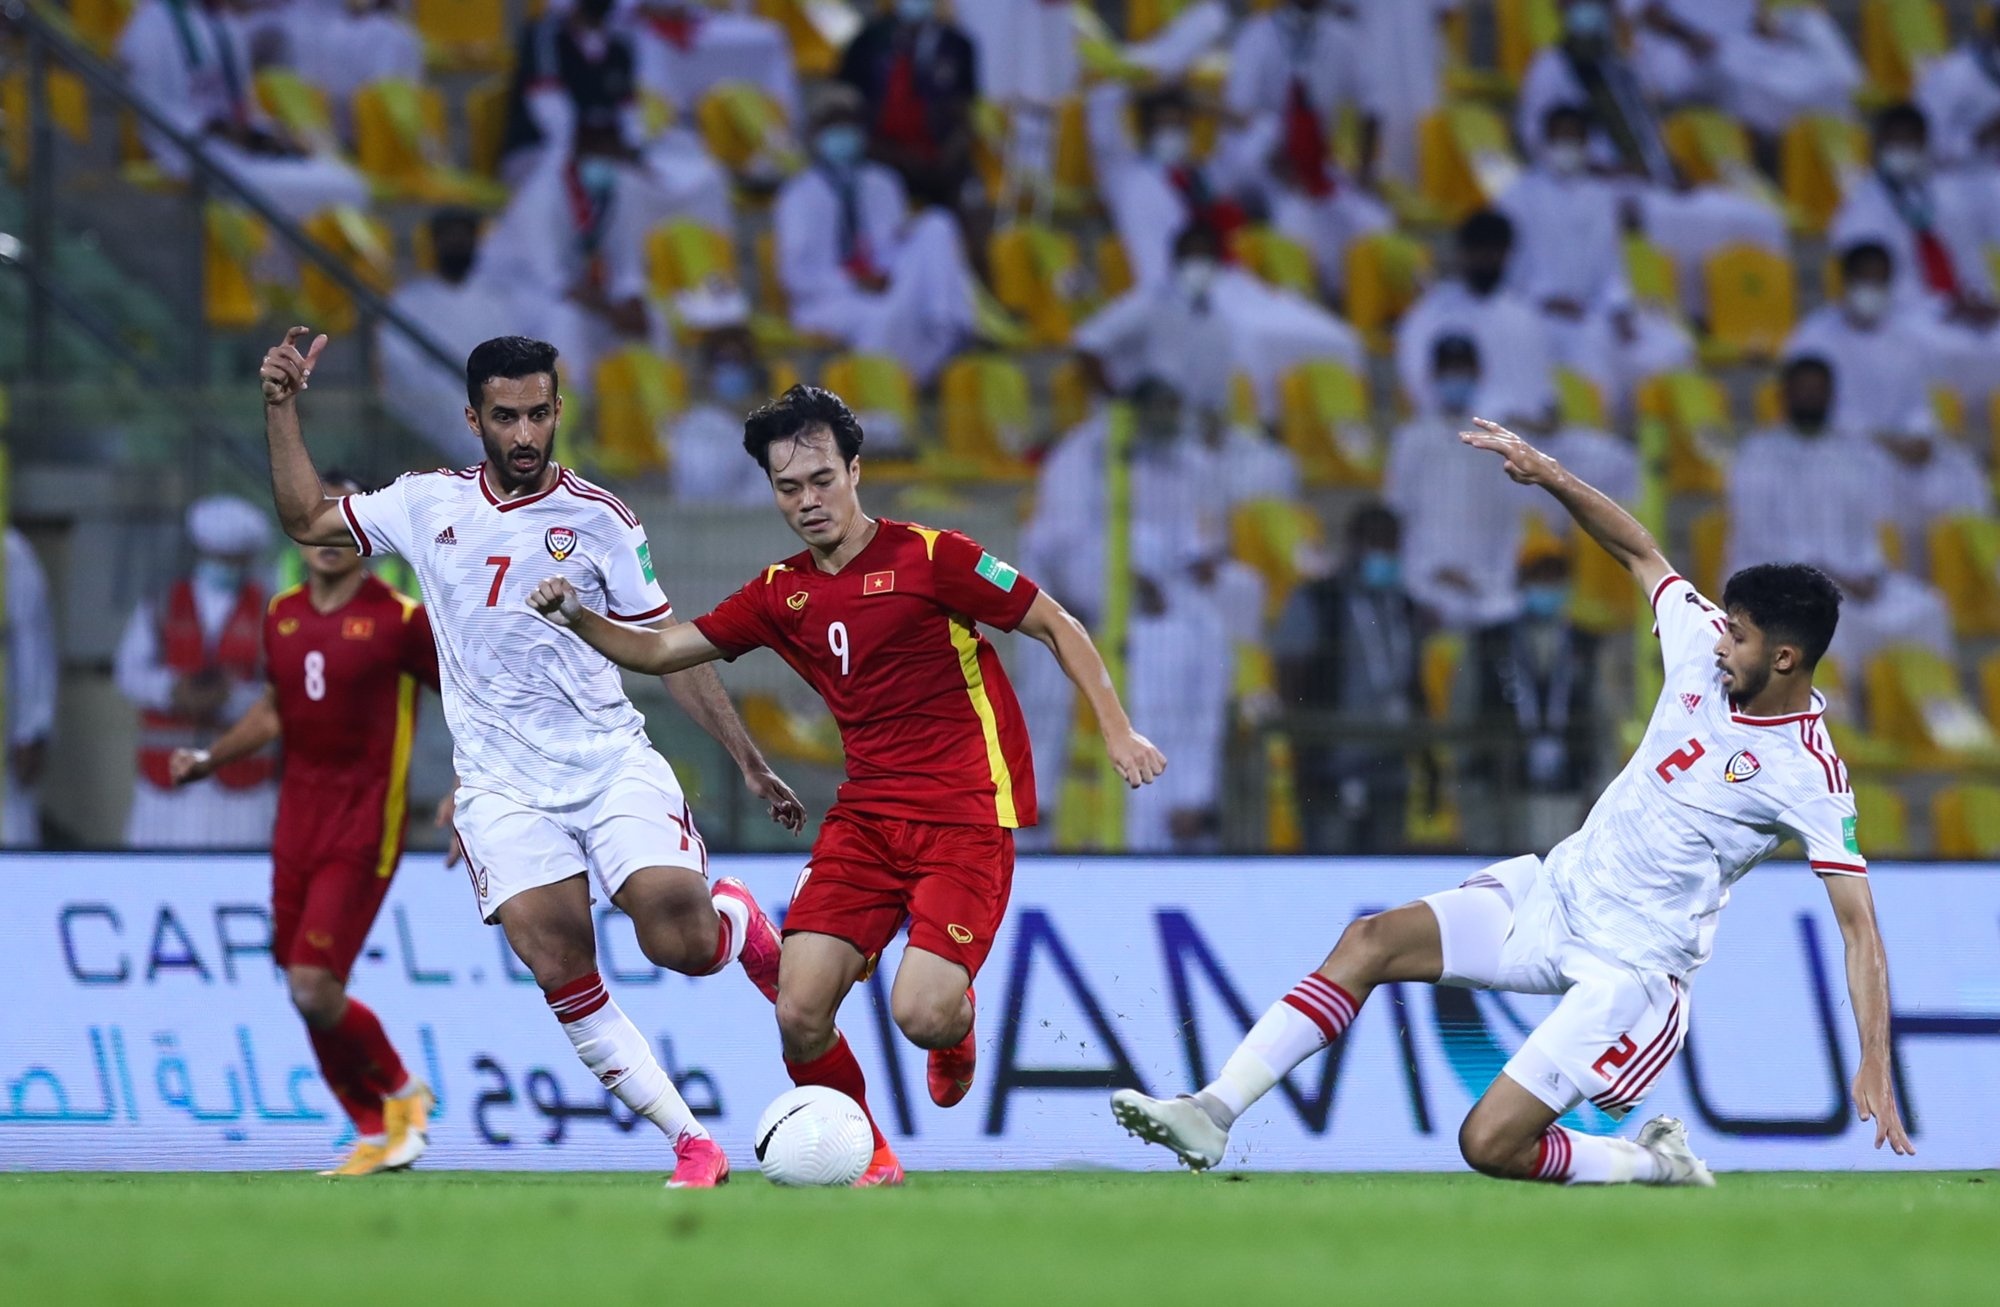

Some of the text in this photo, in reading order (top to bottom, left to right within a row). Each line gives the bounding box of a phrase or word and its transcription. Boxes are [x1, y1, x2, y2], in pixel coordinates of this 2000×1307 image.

[486, 556, 511, 607] 7
[827, 621, 849, 675] 9
[304, 650, 326, 701] 8
[1655, 737, 1705, 784] 2
[1591, 1032, 1638, 1082] 2
